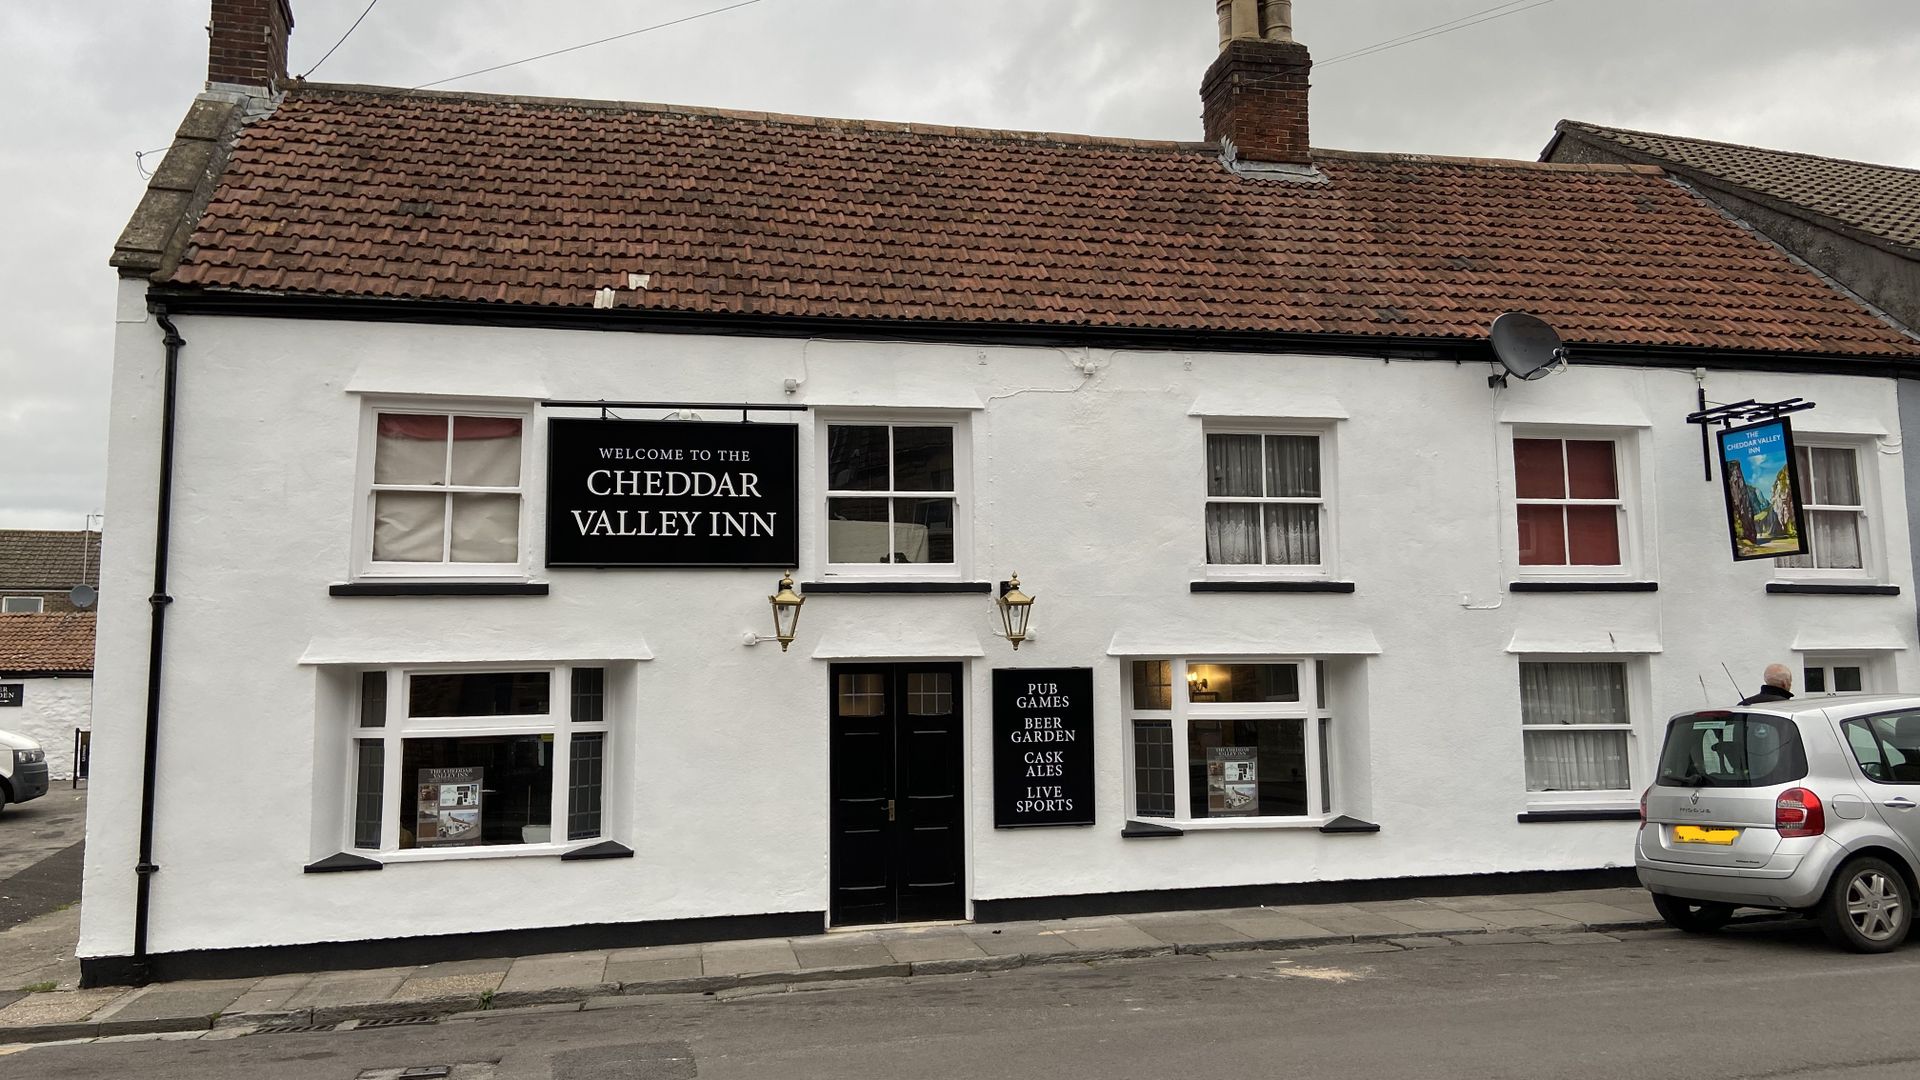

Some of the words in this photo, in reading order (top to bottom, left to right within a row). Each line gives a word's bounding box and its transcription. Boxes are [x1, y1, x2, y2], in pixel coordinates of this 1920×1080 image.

[1727, 440, 1757, 451] CHEDDAR
[1757, 434, 1781, 444] VALLEY
[599, 448, 683, 460] WELCOME
[690, 449, 711, 461] TO
[718, 450, 751, 462] THE
[587, 469, 762, 497] CHEDDAR
[571, 510, 702, 536] VALLEY
[709, 512, 777, 537] INN
[1028, 683, 1058, 695] PUB
[1016, 696, 1070, 708] GAMES
[1025, 717, 1062, 730] BEER
[1011, 730, 1076, 743] GARDEN
[1024, 751, 1064, 764] CASK
[1026, 765, 1063, 777] ALES
[1027, 786, 1062, 799] LIVE
[1016, 799, 1073, 812] SPORTS
